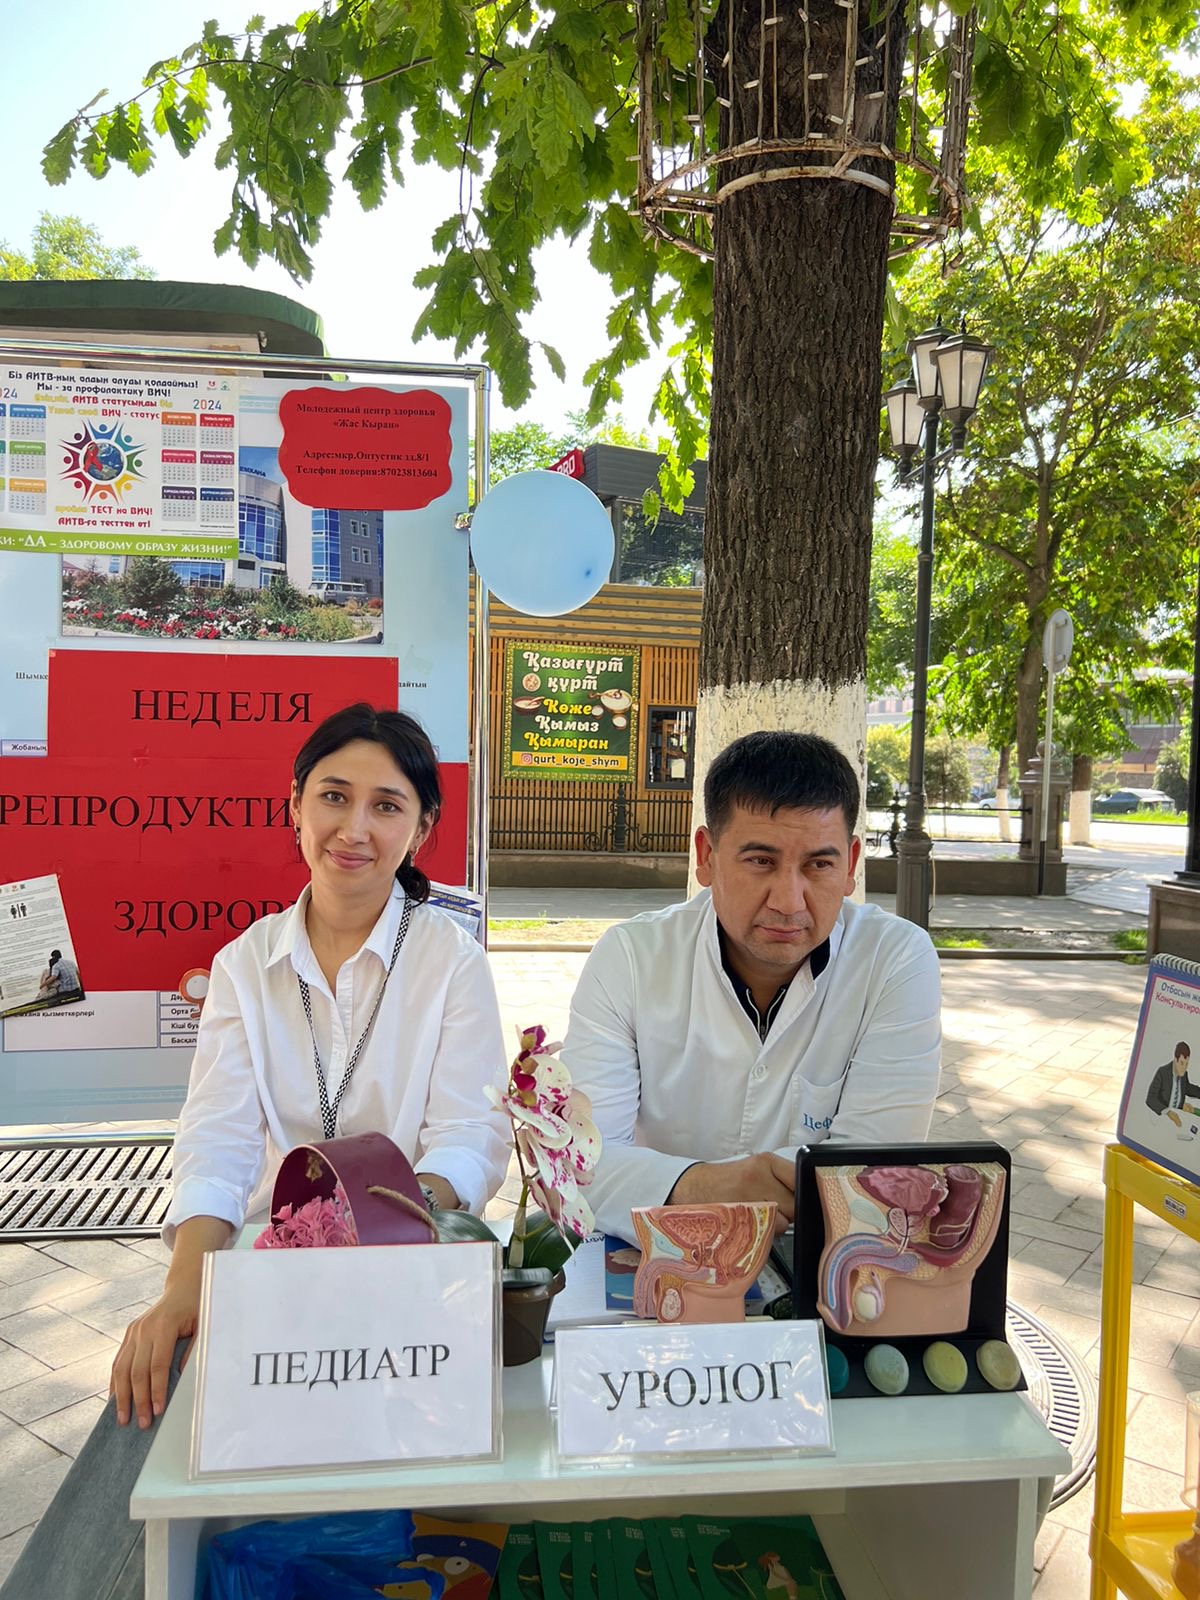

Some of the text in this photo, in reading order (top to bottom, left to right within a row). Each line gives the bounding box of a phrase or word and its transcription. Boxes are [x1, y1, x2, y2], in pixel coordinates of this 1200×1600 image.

[0, 387, 18, 400] 24
[37, 382, 53, 391] Мы
[62, 384, 73, 392] за
[75, 385, 144, 397] профилактику
[147, 388, 171, 397] ВИЧ!
[72, 395, 99, 404] АИТВ
[193, 398, 222, 410] 2024
[101, 408, 121, 417] ВИЧ
[130, 411, 160, 420] статус
[363, 406, 391, 417] центр
[394, 407, 436, 418] здоровья
[295, 464, 337, 476] Телефон
[91, 505, 113, 515] ТЕСТ
[116, 507, 127, 515] на
[130, 506, 153, 515] ВИЧ!
[59, 538, 132, 551] ЗДОРОВОМУ
[135, 541, 180, 553] ОБРАЗУ
[131, 689, 314, 729] НЕДЕЛЯ
[543, 698, 593, 715] Көже
[535, 714, 600, 734] Қымыз
[523, 732, 609, 752] Қымыран
[0, 794, 292, 833] РЕПРОДУКТИ
[250, 1343, 451, 1392] ПЕДИАТР
[598, 1360, 793, 1411] УРОЛОГ
